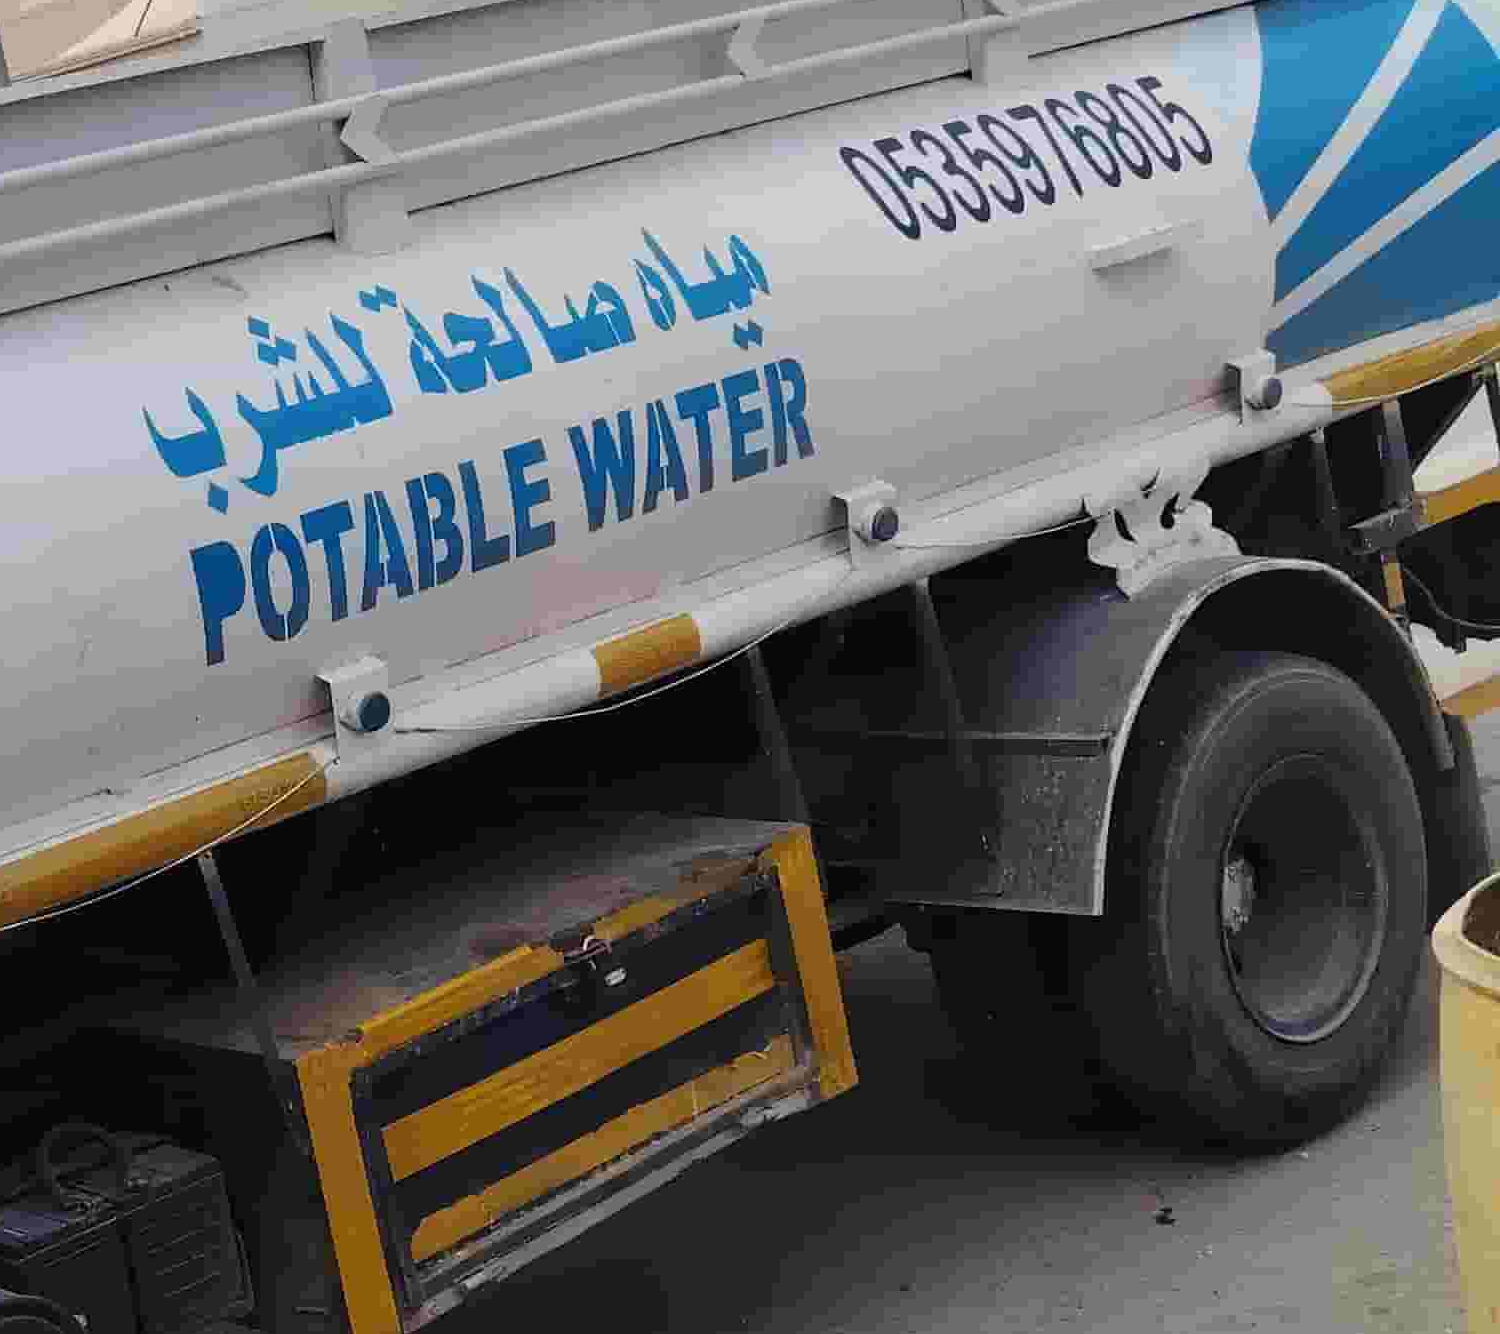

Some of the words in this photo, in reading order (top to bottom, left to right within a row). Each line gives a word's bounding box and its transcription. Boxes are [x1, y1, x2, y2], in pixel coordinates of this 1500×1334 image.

[838, 75, 1214, 240] 0535976805
[357, 266, 638, 395] صالحة
[632, 226, 772, 352] مياه
[140, 307, 395, 516] للشرب
[188, 438, 557, 668] POTABLE
[566, 356, 816, 534] WATER
